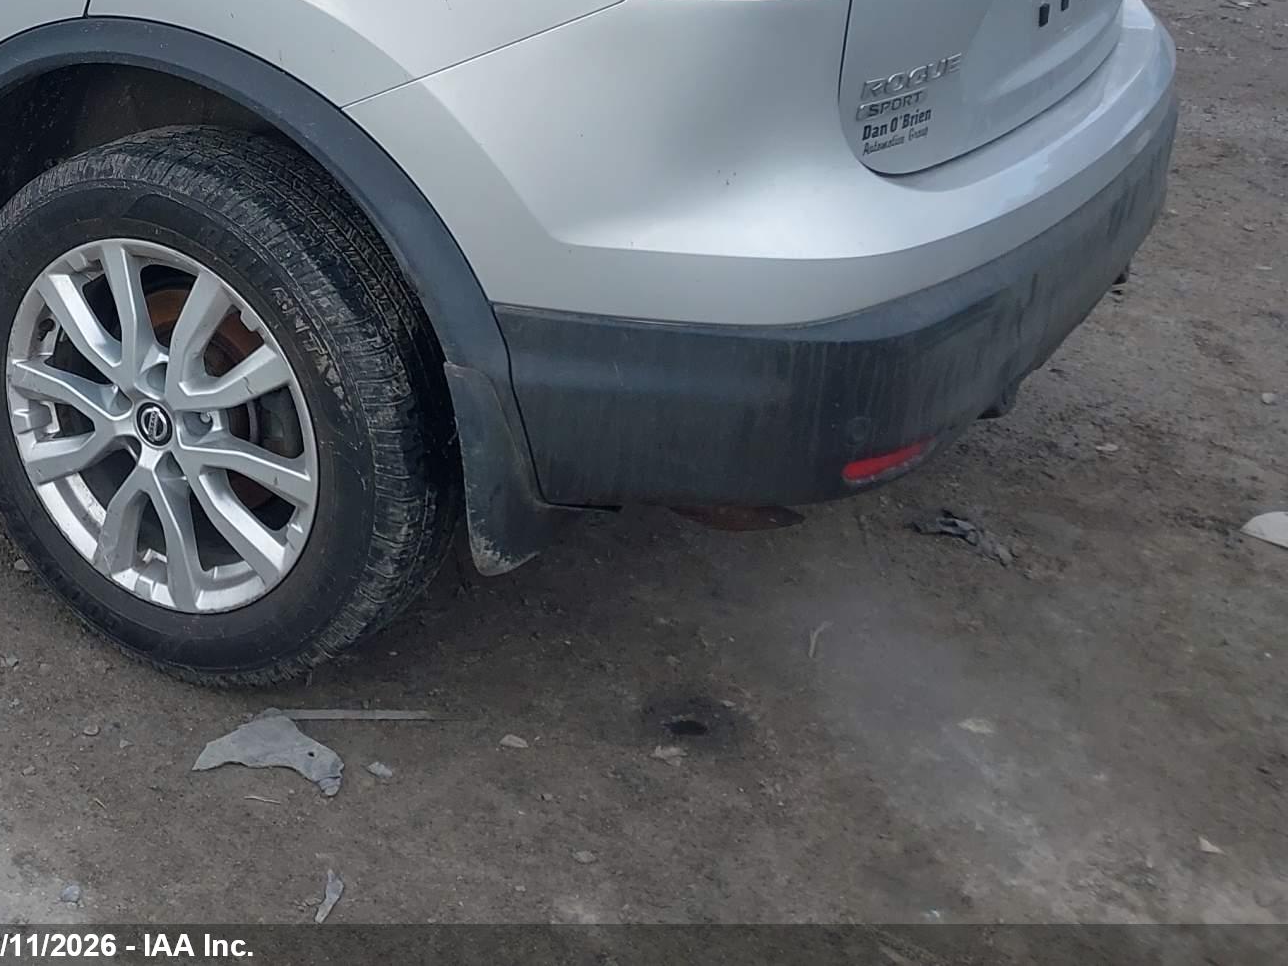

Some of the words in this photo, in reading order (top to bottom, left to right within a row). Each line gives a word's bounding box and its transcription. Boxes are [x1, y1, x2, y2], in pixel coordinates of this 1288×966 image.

[861, 52, 962, 100] ROGUE
[868, 91, 923, 117] SPORT
[862, 123, 888, 141] Dan
[890, 109, 932, 133] O'Brien
